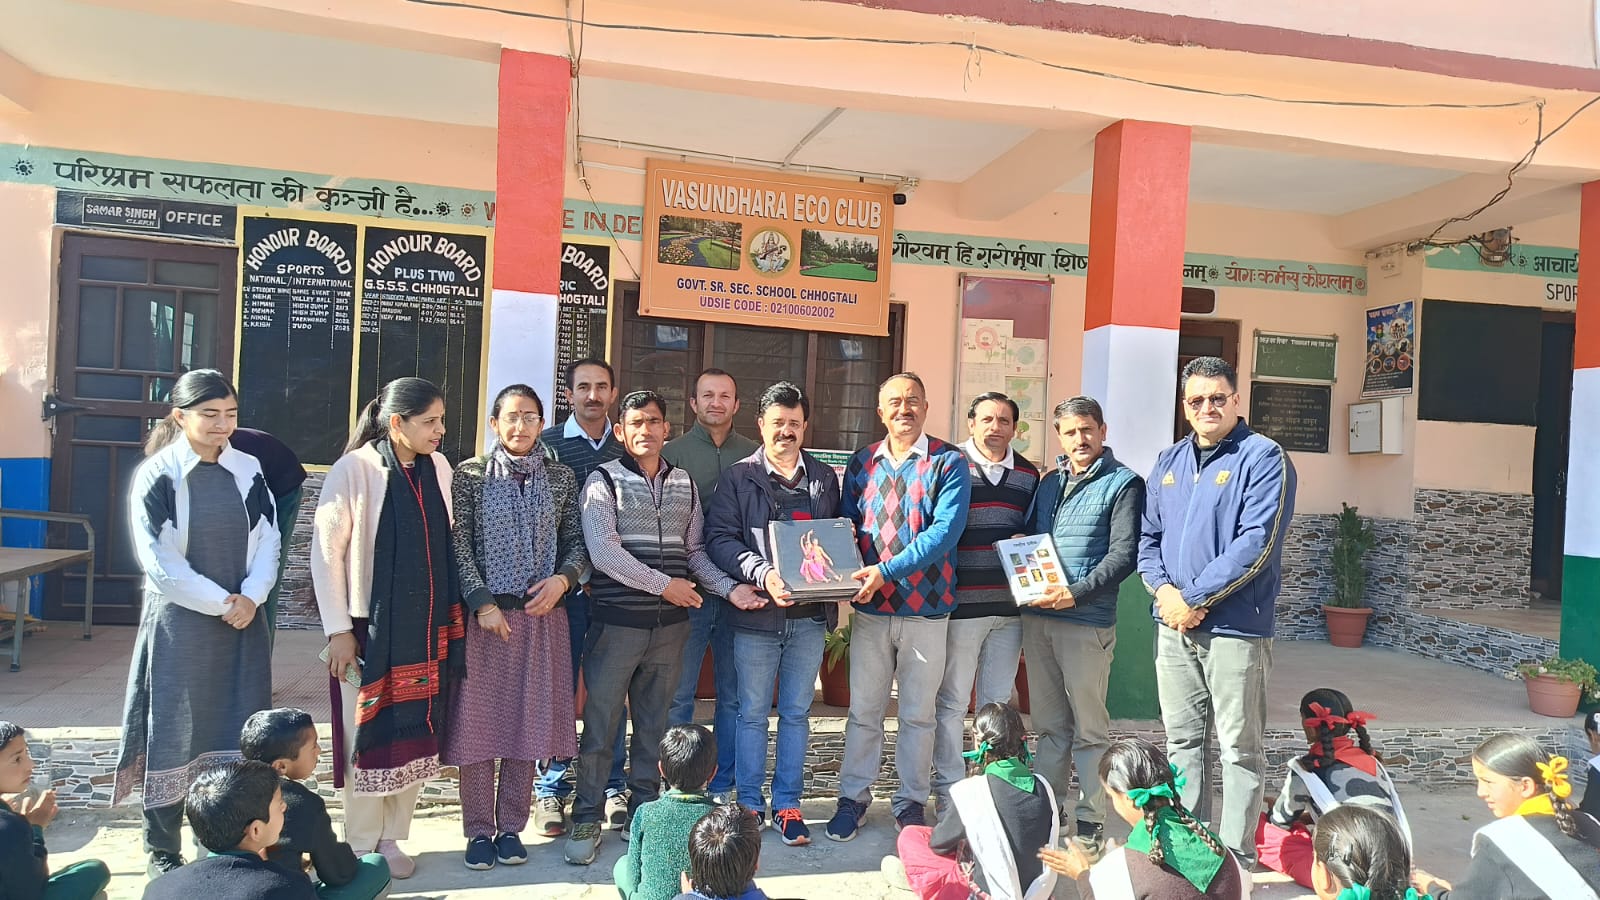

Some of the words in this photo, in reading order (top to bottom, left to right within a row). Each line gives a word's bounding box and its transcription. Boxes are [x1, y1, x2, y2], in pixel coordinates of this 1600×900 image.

[53, 158, 154, 189] परिश्रम
[160, 171, 265, 202] सफलता
[271, 177, 308, 203] की
[86, 204, 123, 217] SAMAR
[124, 207, 157, 220] SINGH
[662, 178, 788, 220] VASUNDHARA
[793, 193, 830, 225] ECO
[835, 198, 882, 229] CLUB
[165, 211, 223, 227] OFFICE
[613, 215, 643, 235] DE
[246, 228, 300, 271] HONOUR
[306, 228, 352, 275] BOARD
[366, 235, 432, 276] HONOUR
[434, 237, 483, 282] BOARD
[954, 241, 975, 265] हि
[1051, 248, 1089, 272] शिष
[276, 264, 325, 276] SPORTS
[393, 267, 424, 280] PLUS
[428, 270, 455, 282] TWO
[561, 244, 609, 291] BOARD
[364, 279, 409, 292] G.S.S.S.
[411, 282, 479, 298] CHHOGTALI
[559, 280, 576, 291] RIC
[677, 277, 707, 291] GOVT.
[710, 280, 728, 293] SR.
[729, 282, 753, 296] SEC.
[755, 284, 798, 299] SCHOOL
[799, 288, 858, 305] CHHOGTALI
[1546, 283, 1578, 302] SPOR
[559, 294, 605, 306] HOGTALI
[699, 295, 731, 309] UDSIE
[734, 299, 762, 312] CODE
[770, 301, 835, 318] 02100602002
